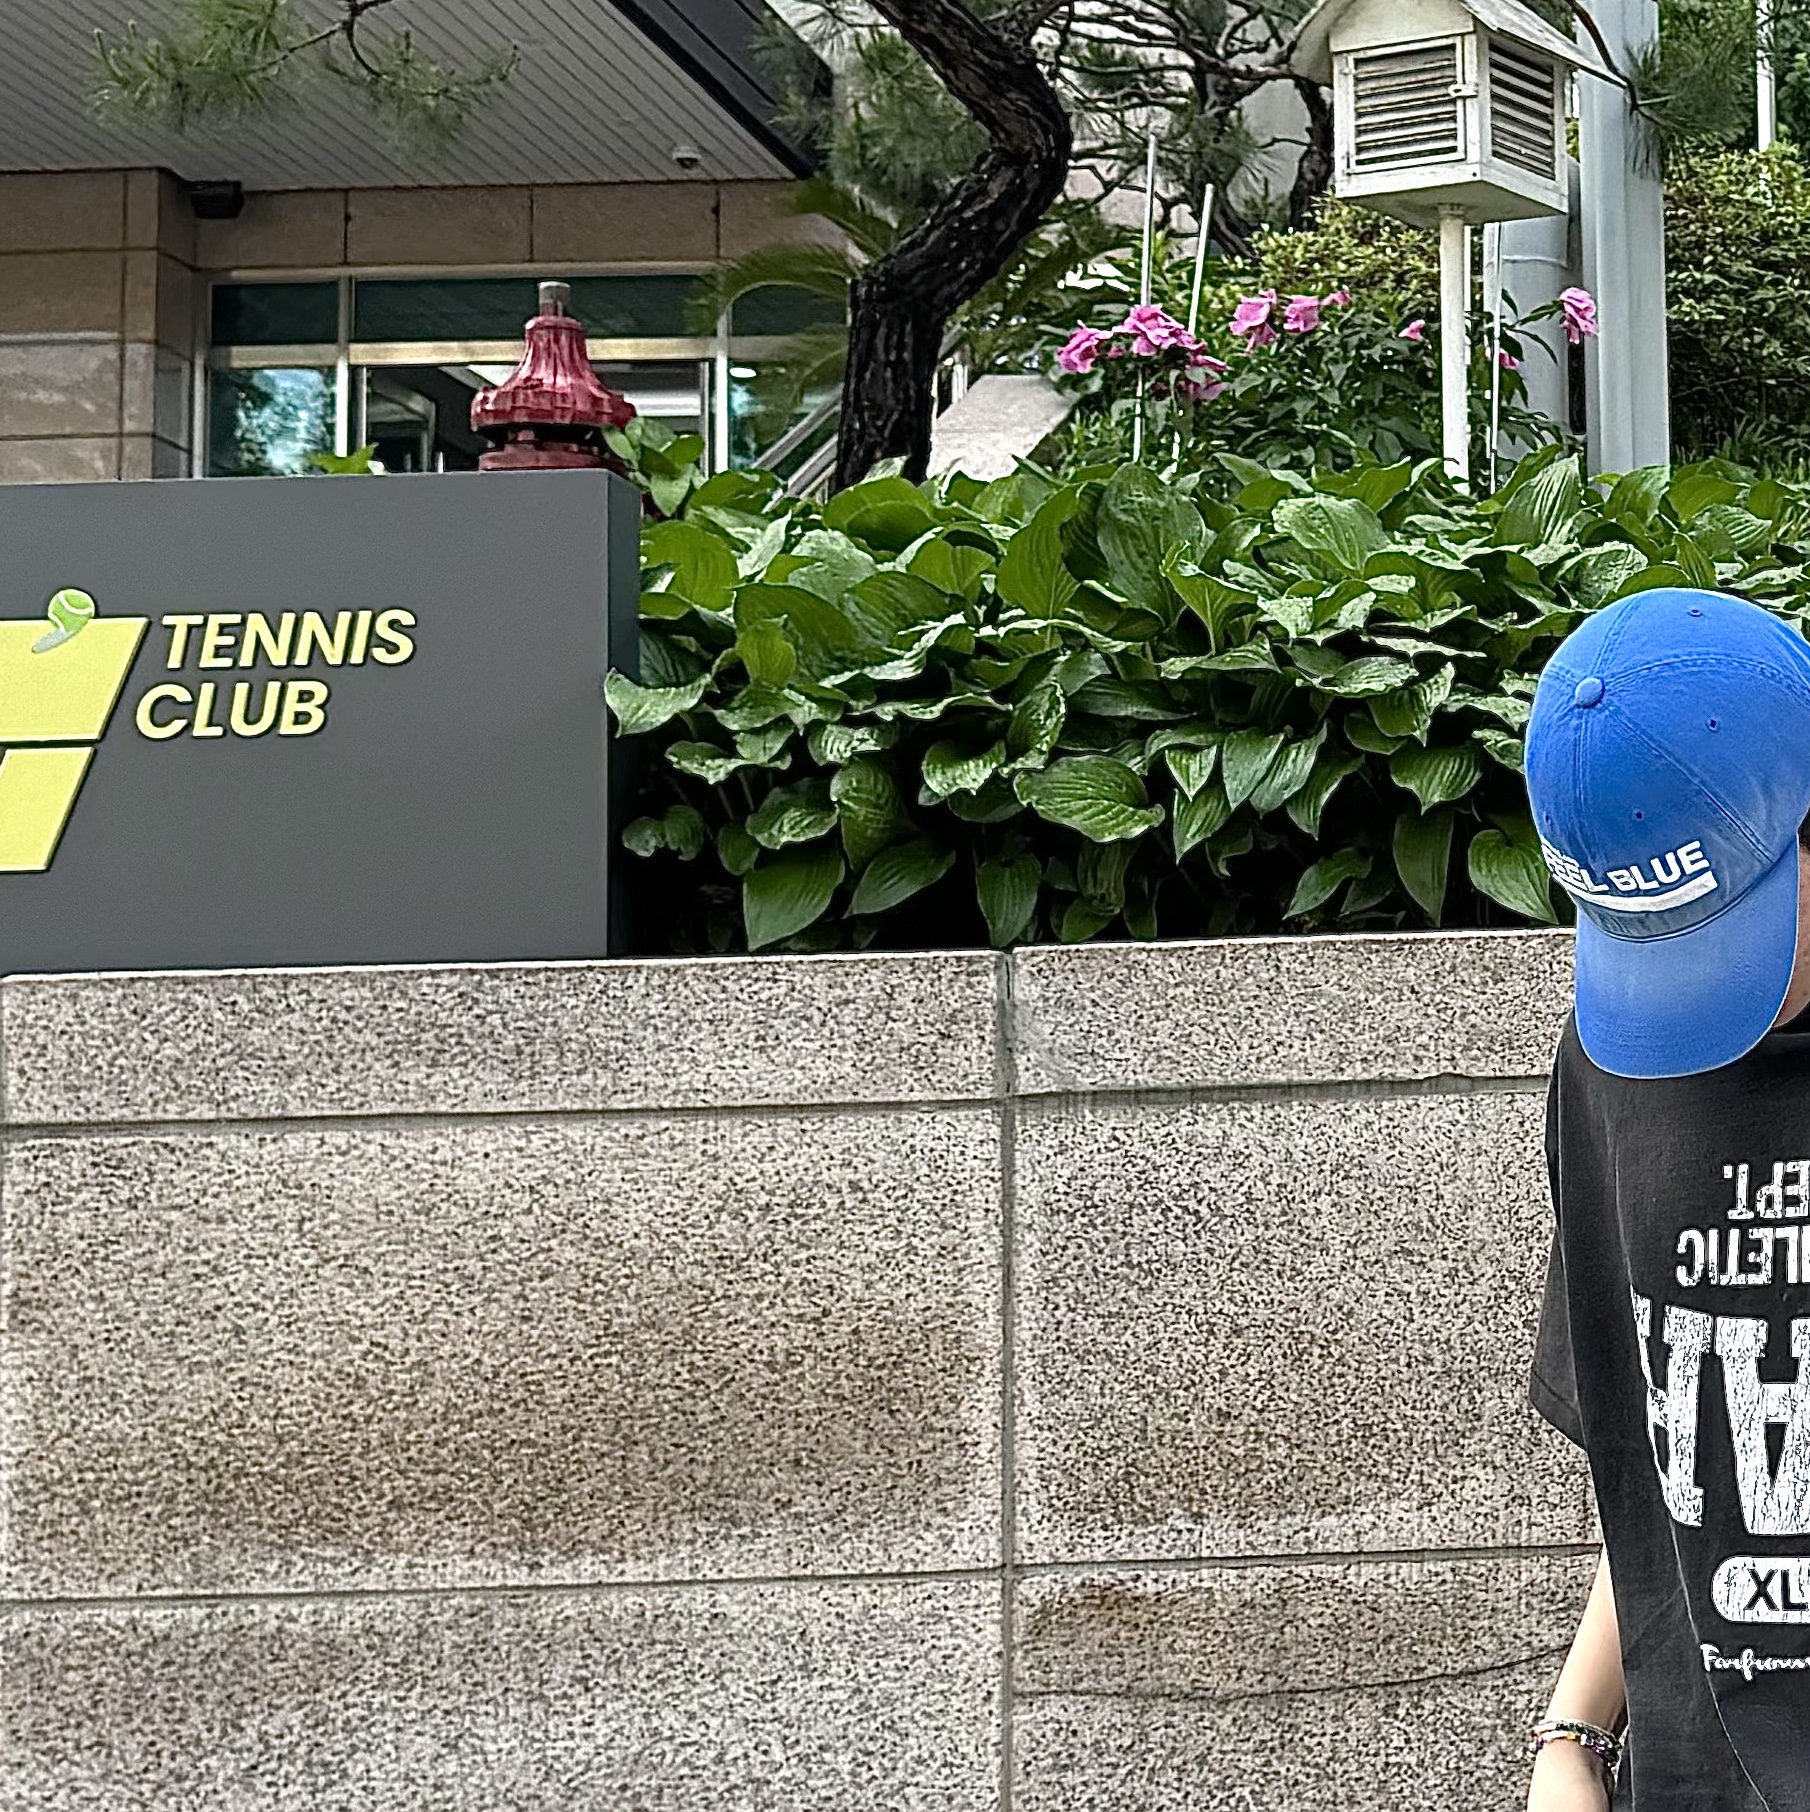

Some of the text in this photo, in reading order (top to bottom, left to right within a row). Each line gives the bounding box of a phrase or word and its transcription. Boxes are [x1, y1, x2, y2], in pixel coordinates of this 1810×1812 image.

[162, 609, 417, 670] TENNIS
[136, 680, 331, 739] CLUB
[1606, 840, 1712, 892] BLUE
[1744, 1567, 1809, 1612] XL
